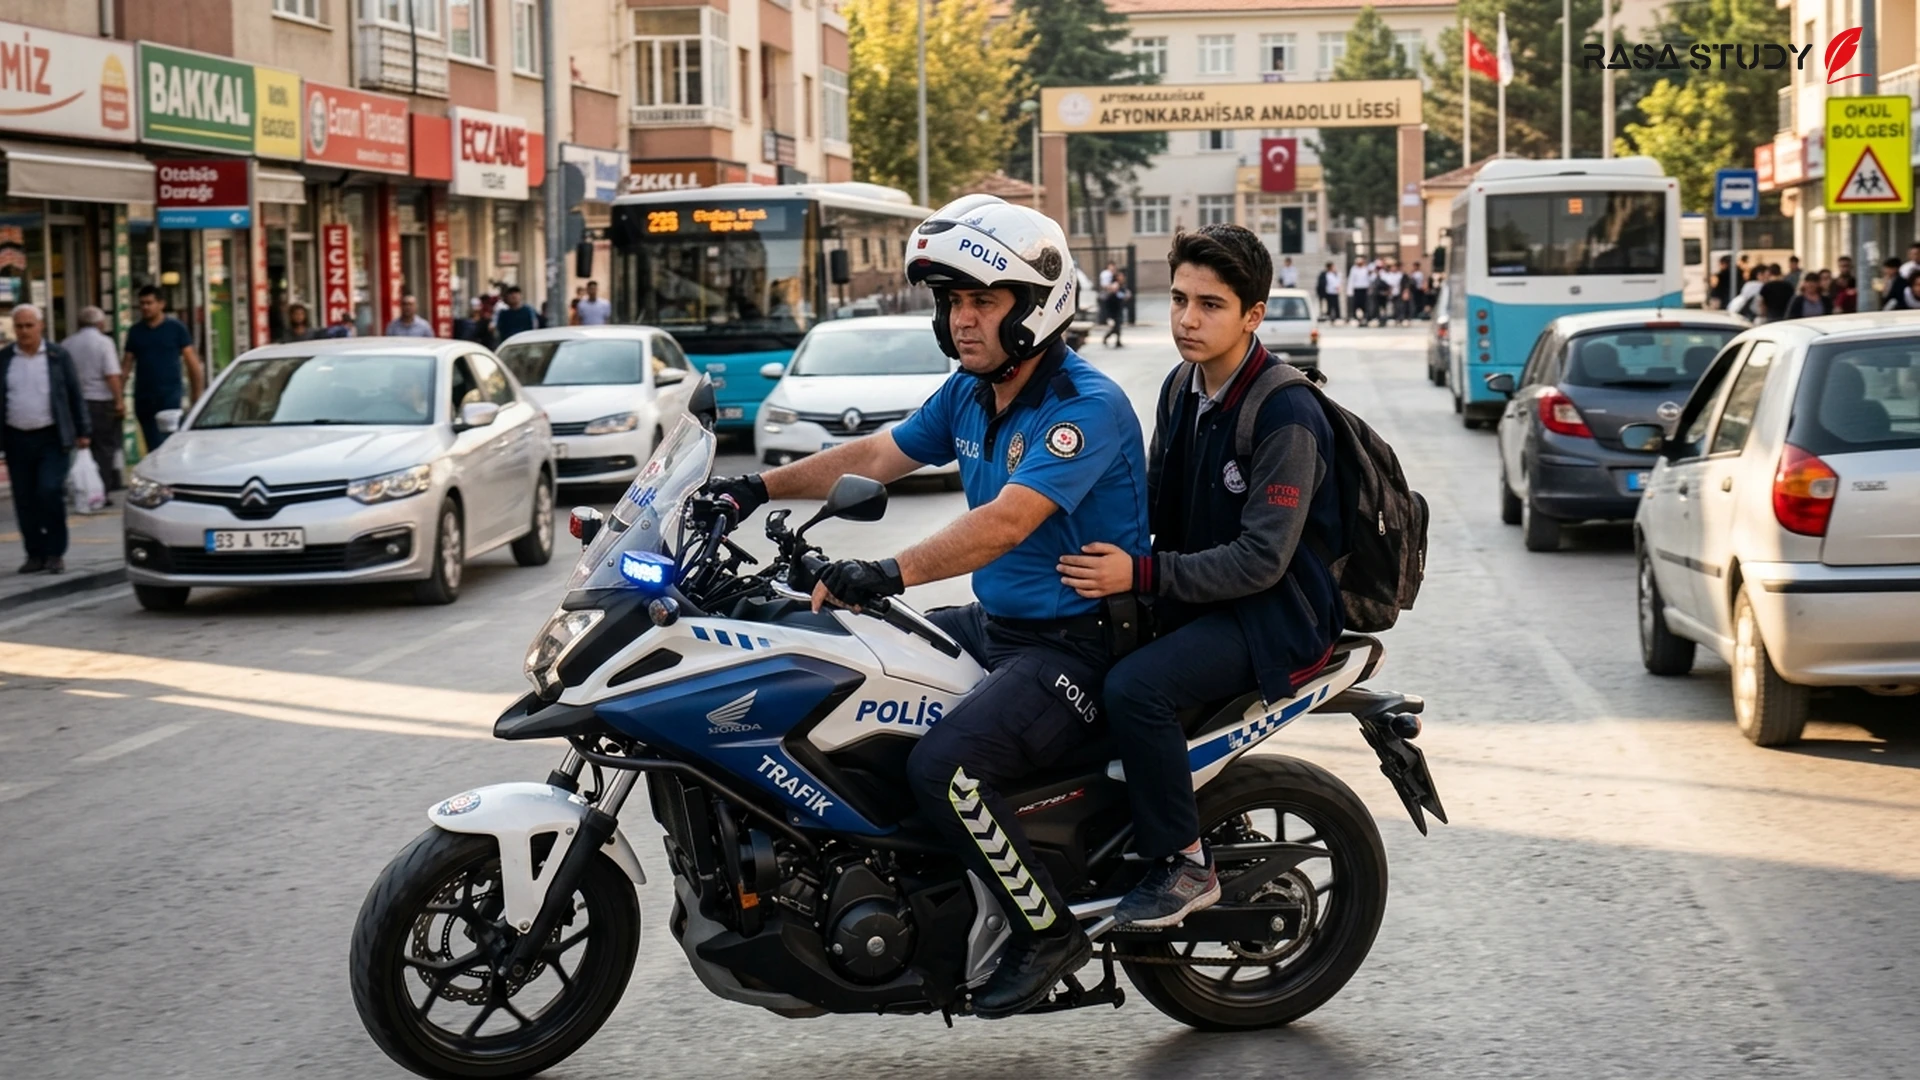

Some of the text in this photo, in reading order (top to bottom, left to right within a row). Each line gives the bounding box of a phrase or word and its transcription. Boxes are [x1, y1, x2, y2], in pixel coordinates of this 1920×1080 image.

[149, 61, 250, 126] BAKKAL
[1100, 97, 1400, 124] AFYONKARAHİSAR ANADOLU LİSESİ
[1845, 104, 1892, 118] OKUL
[461, 118, 526, 168] ECZANE
[855, 696, 943, 728] POLİS
